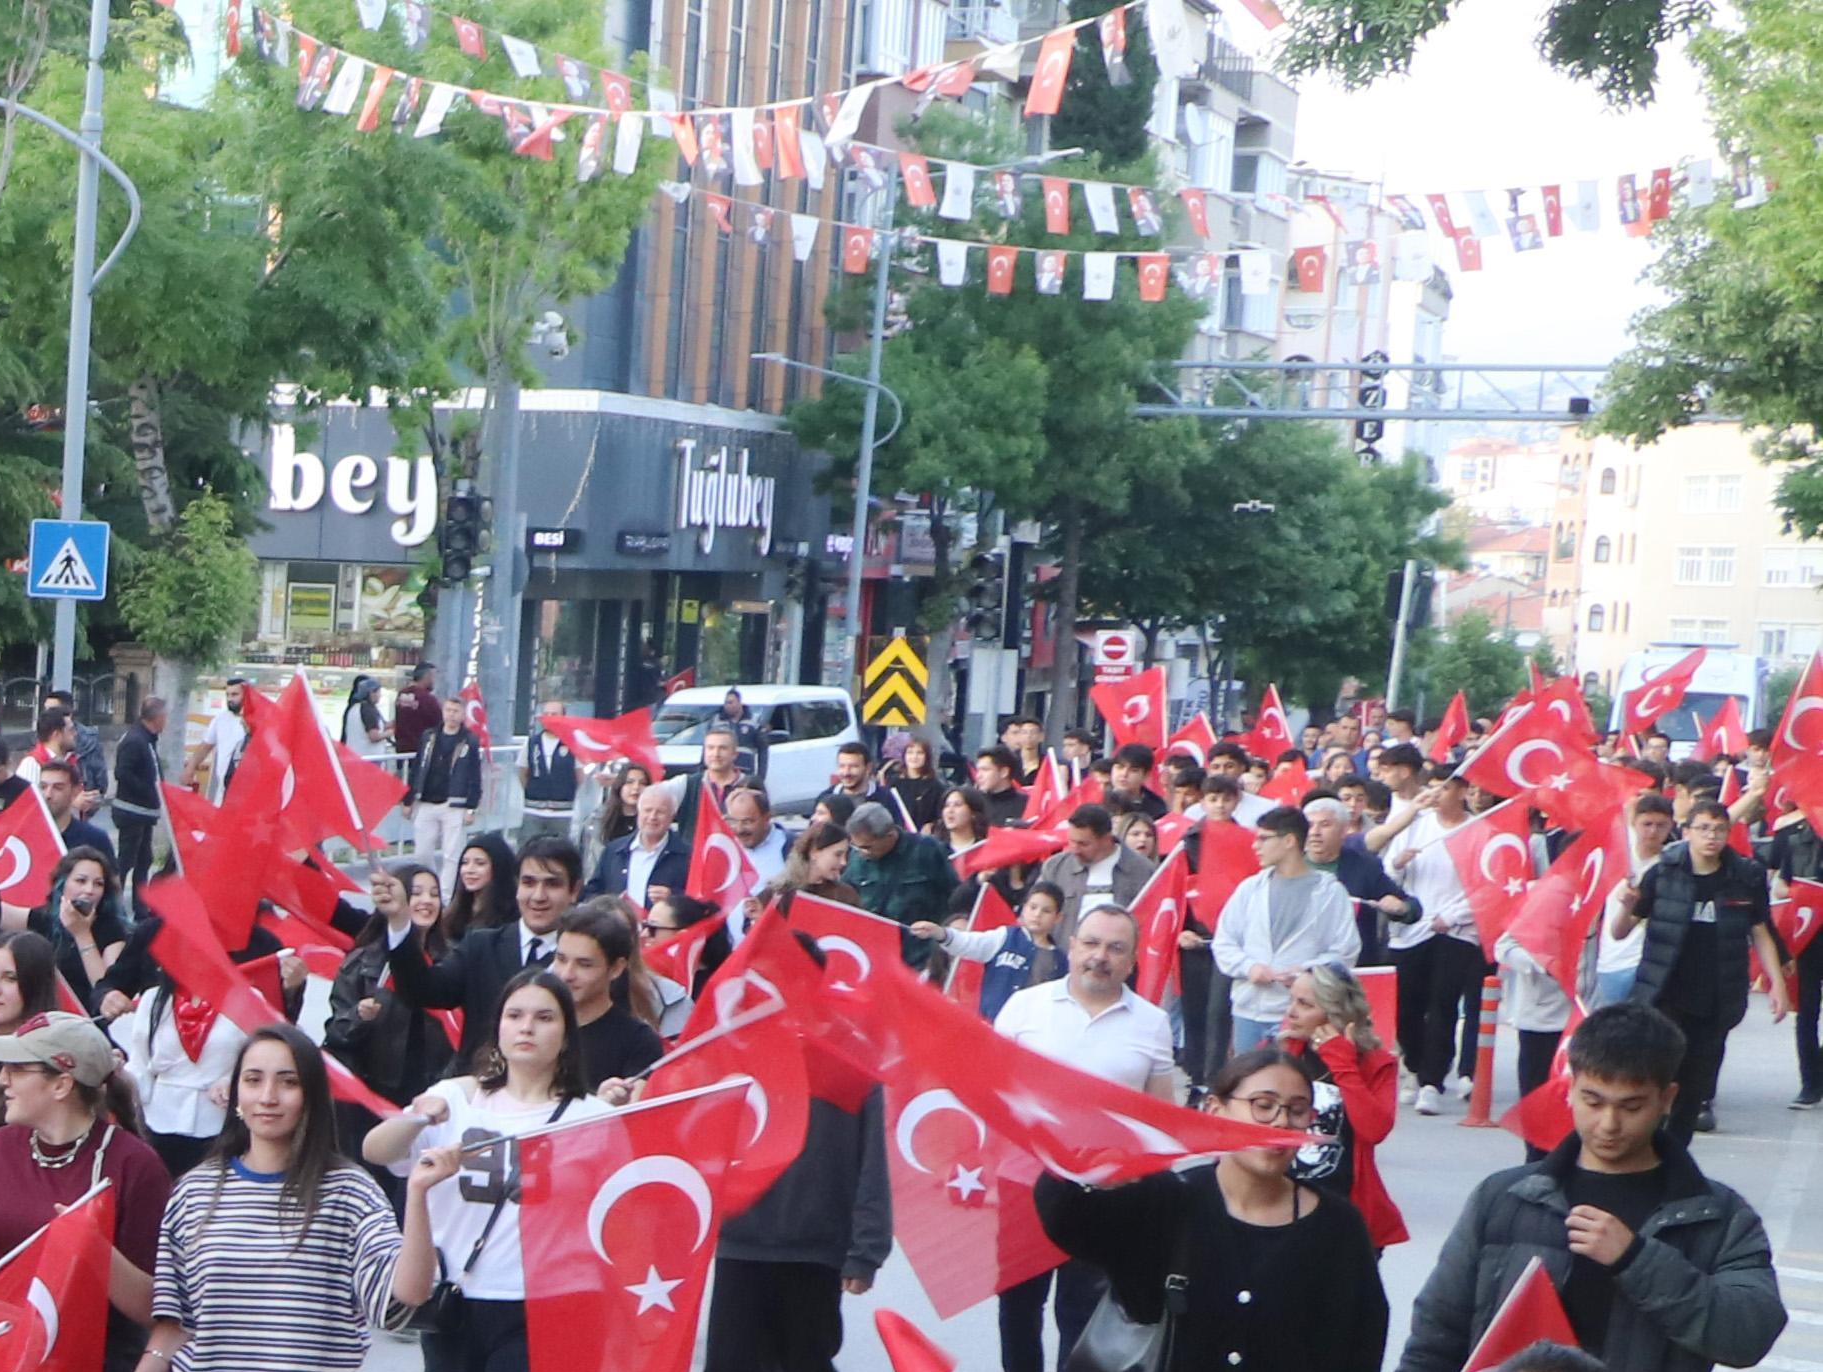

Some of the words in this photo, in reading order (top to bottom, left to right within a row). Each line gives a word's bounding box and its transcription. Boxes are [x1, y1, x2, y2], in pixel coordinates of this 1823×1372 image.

[270, 423, 439, 547] bey
[533, 530, 565, 546] BESİ
[677, 438, 775, 557] Tuğlubey
